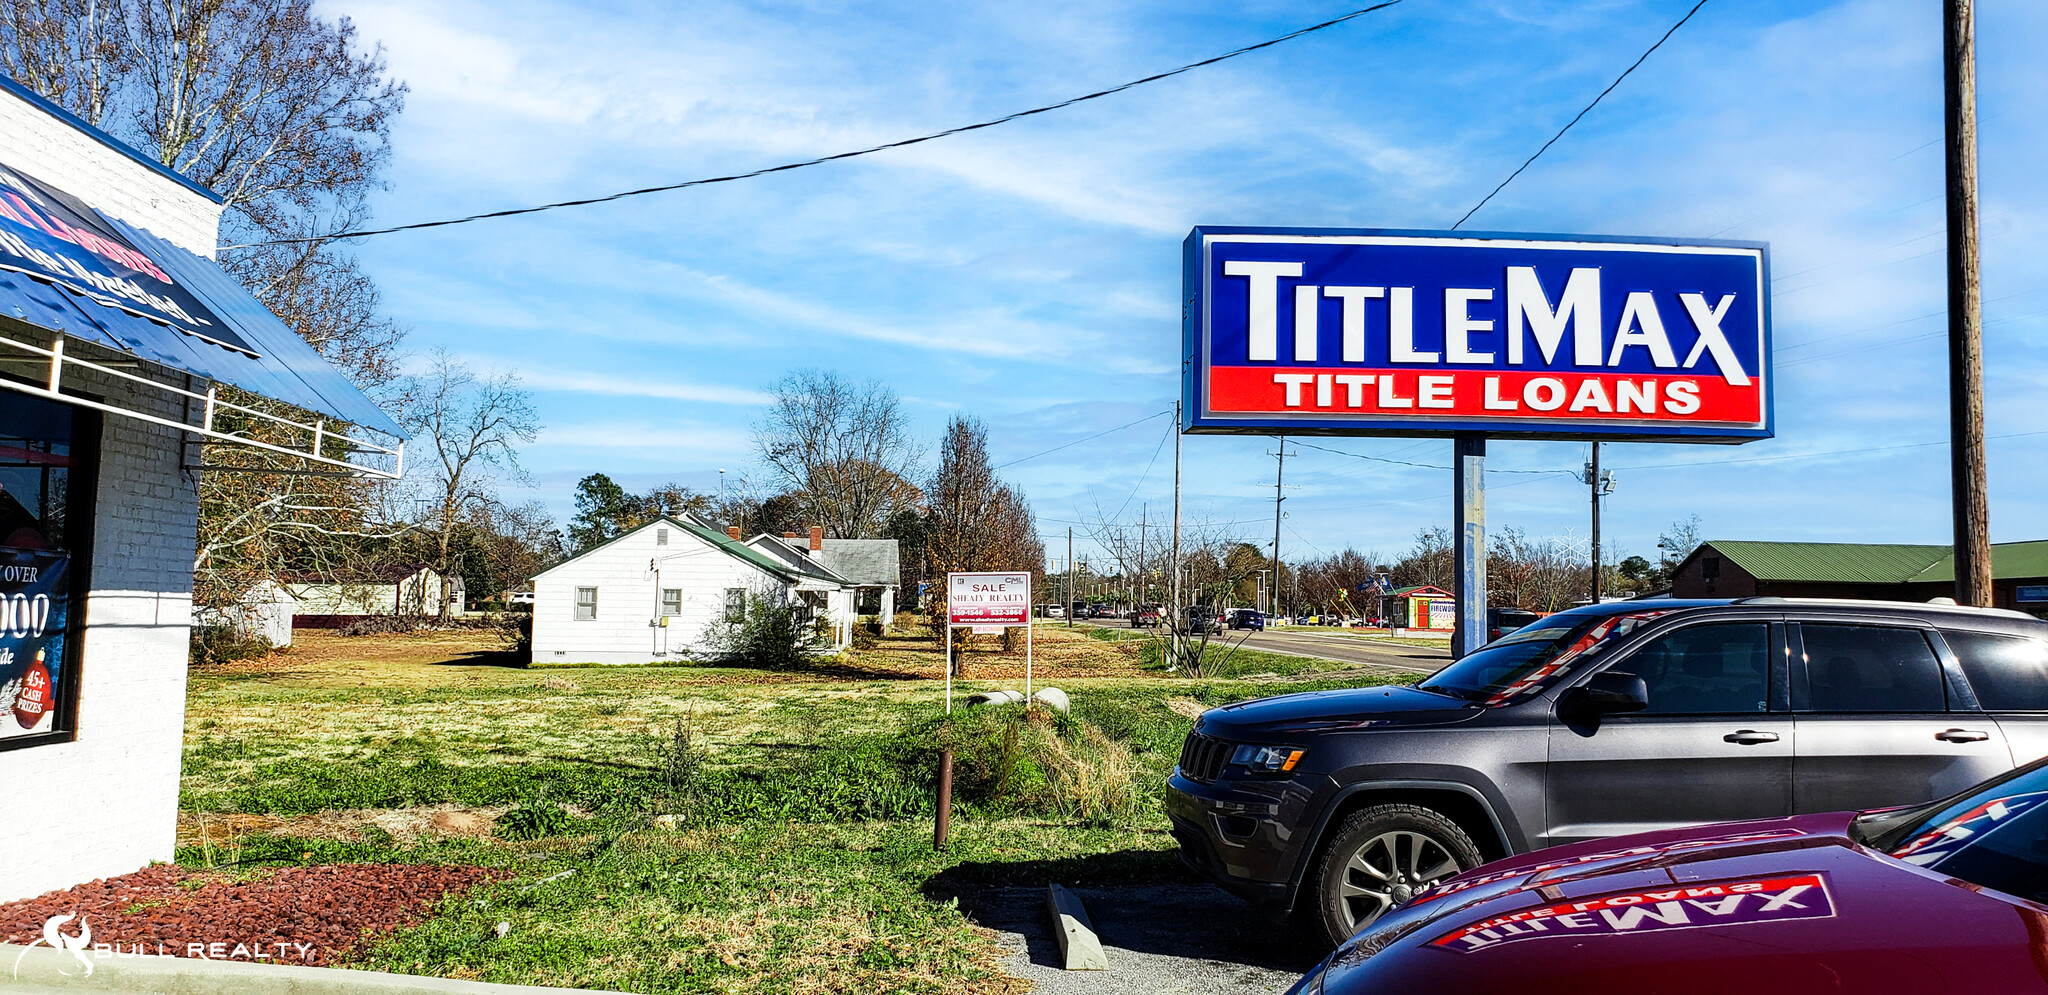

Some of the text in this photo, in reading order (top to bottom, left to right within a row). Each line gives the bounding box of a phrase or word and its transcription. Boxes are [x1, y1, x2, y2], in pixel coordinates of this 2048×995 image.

[5, 191, 174, 285] Loans
[1274, 373, 1702, 416] TITLE LOANS
[4, 565, 38, 583] OVER
[972, 583, 1006, 592] SALE
[953, 594, 1024, 602] SHEALY REALTY
[27, 670, 46, 689] 45+
[22, 687, 42, 702] CASH
[17, 699, 43, 714] PRIZES
